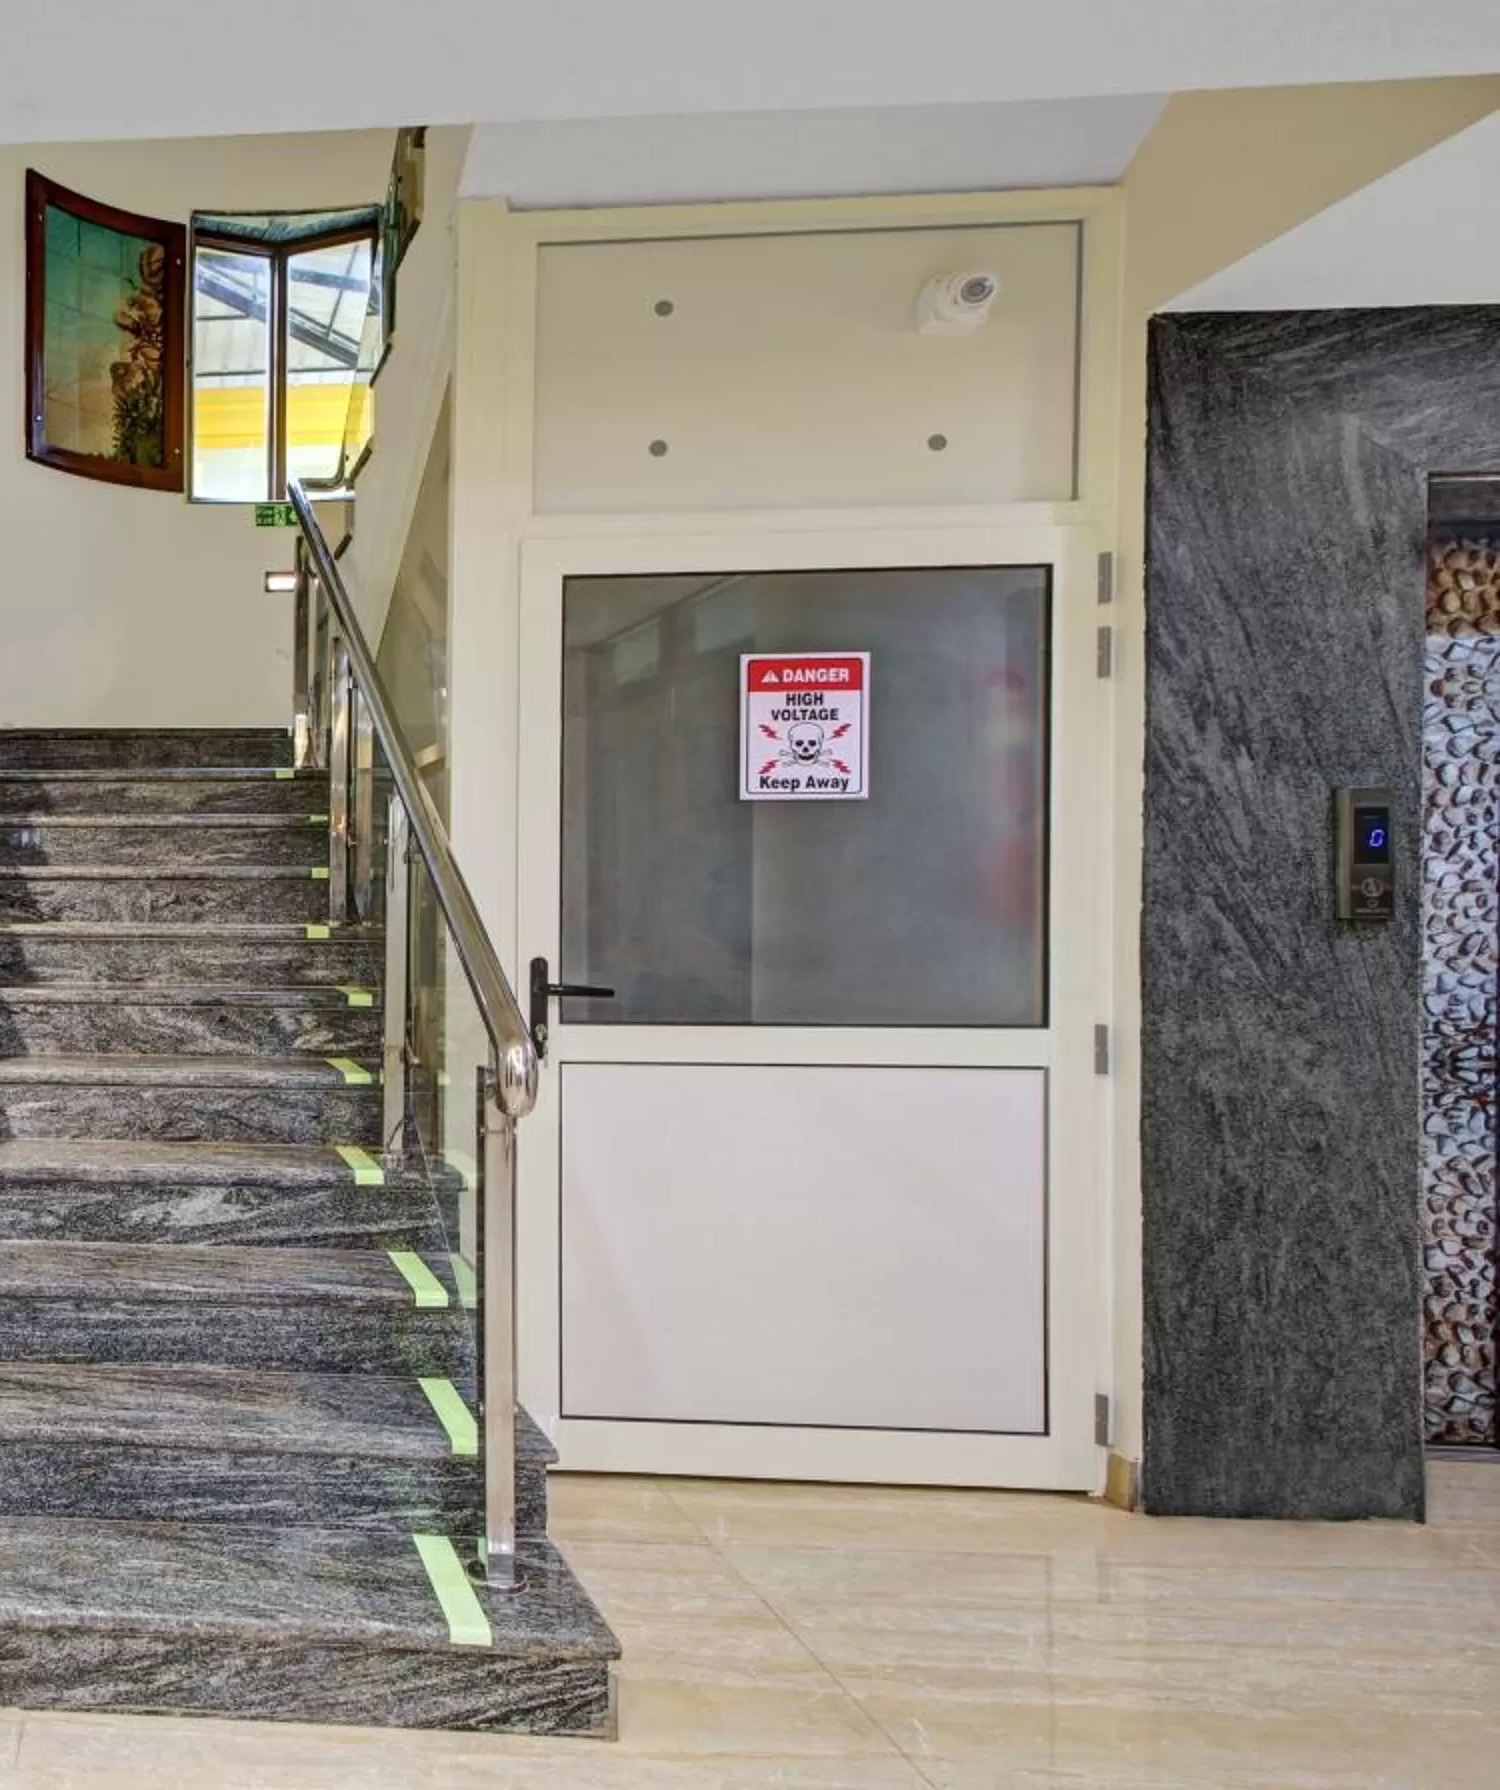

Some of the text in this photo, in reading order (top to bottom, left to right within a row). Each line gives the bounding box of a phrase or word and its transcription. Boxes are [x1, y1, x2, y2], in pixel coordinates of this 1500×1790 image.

[782, 667, 849, 683] DANGER
[785, 692, 824, 706] HIGH
[771, 707, 840, 721] VOLTAGE
[759, 775, 849, 792] Keep Away
[1369, 829, 1384, 847] 0
